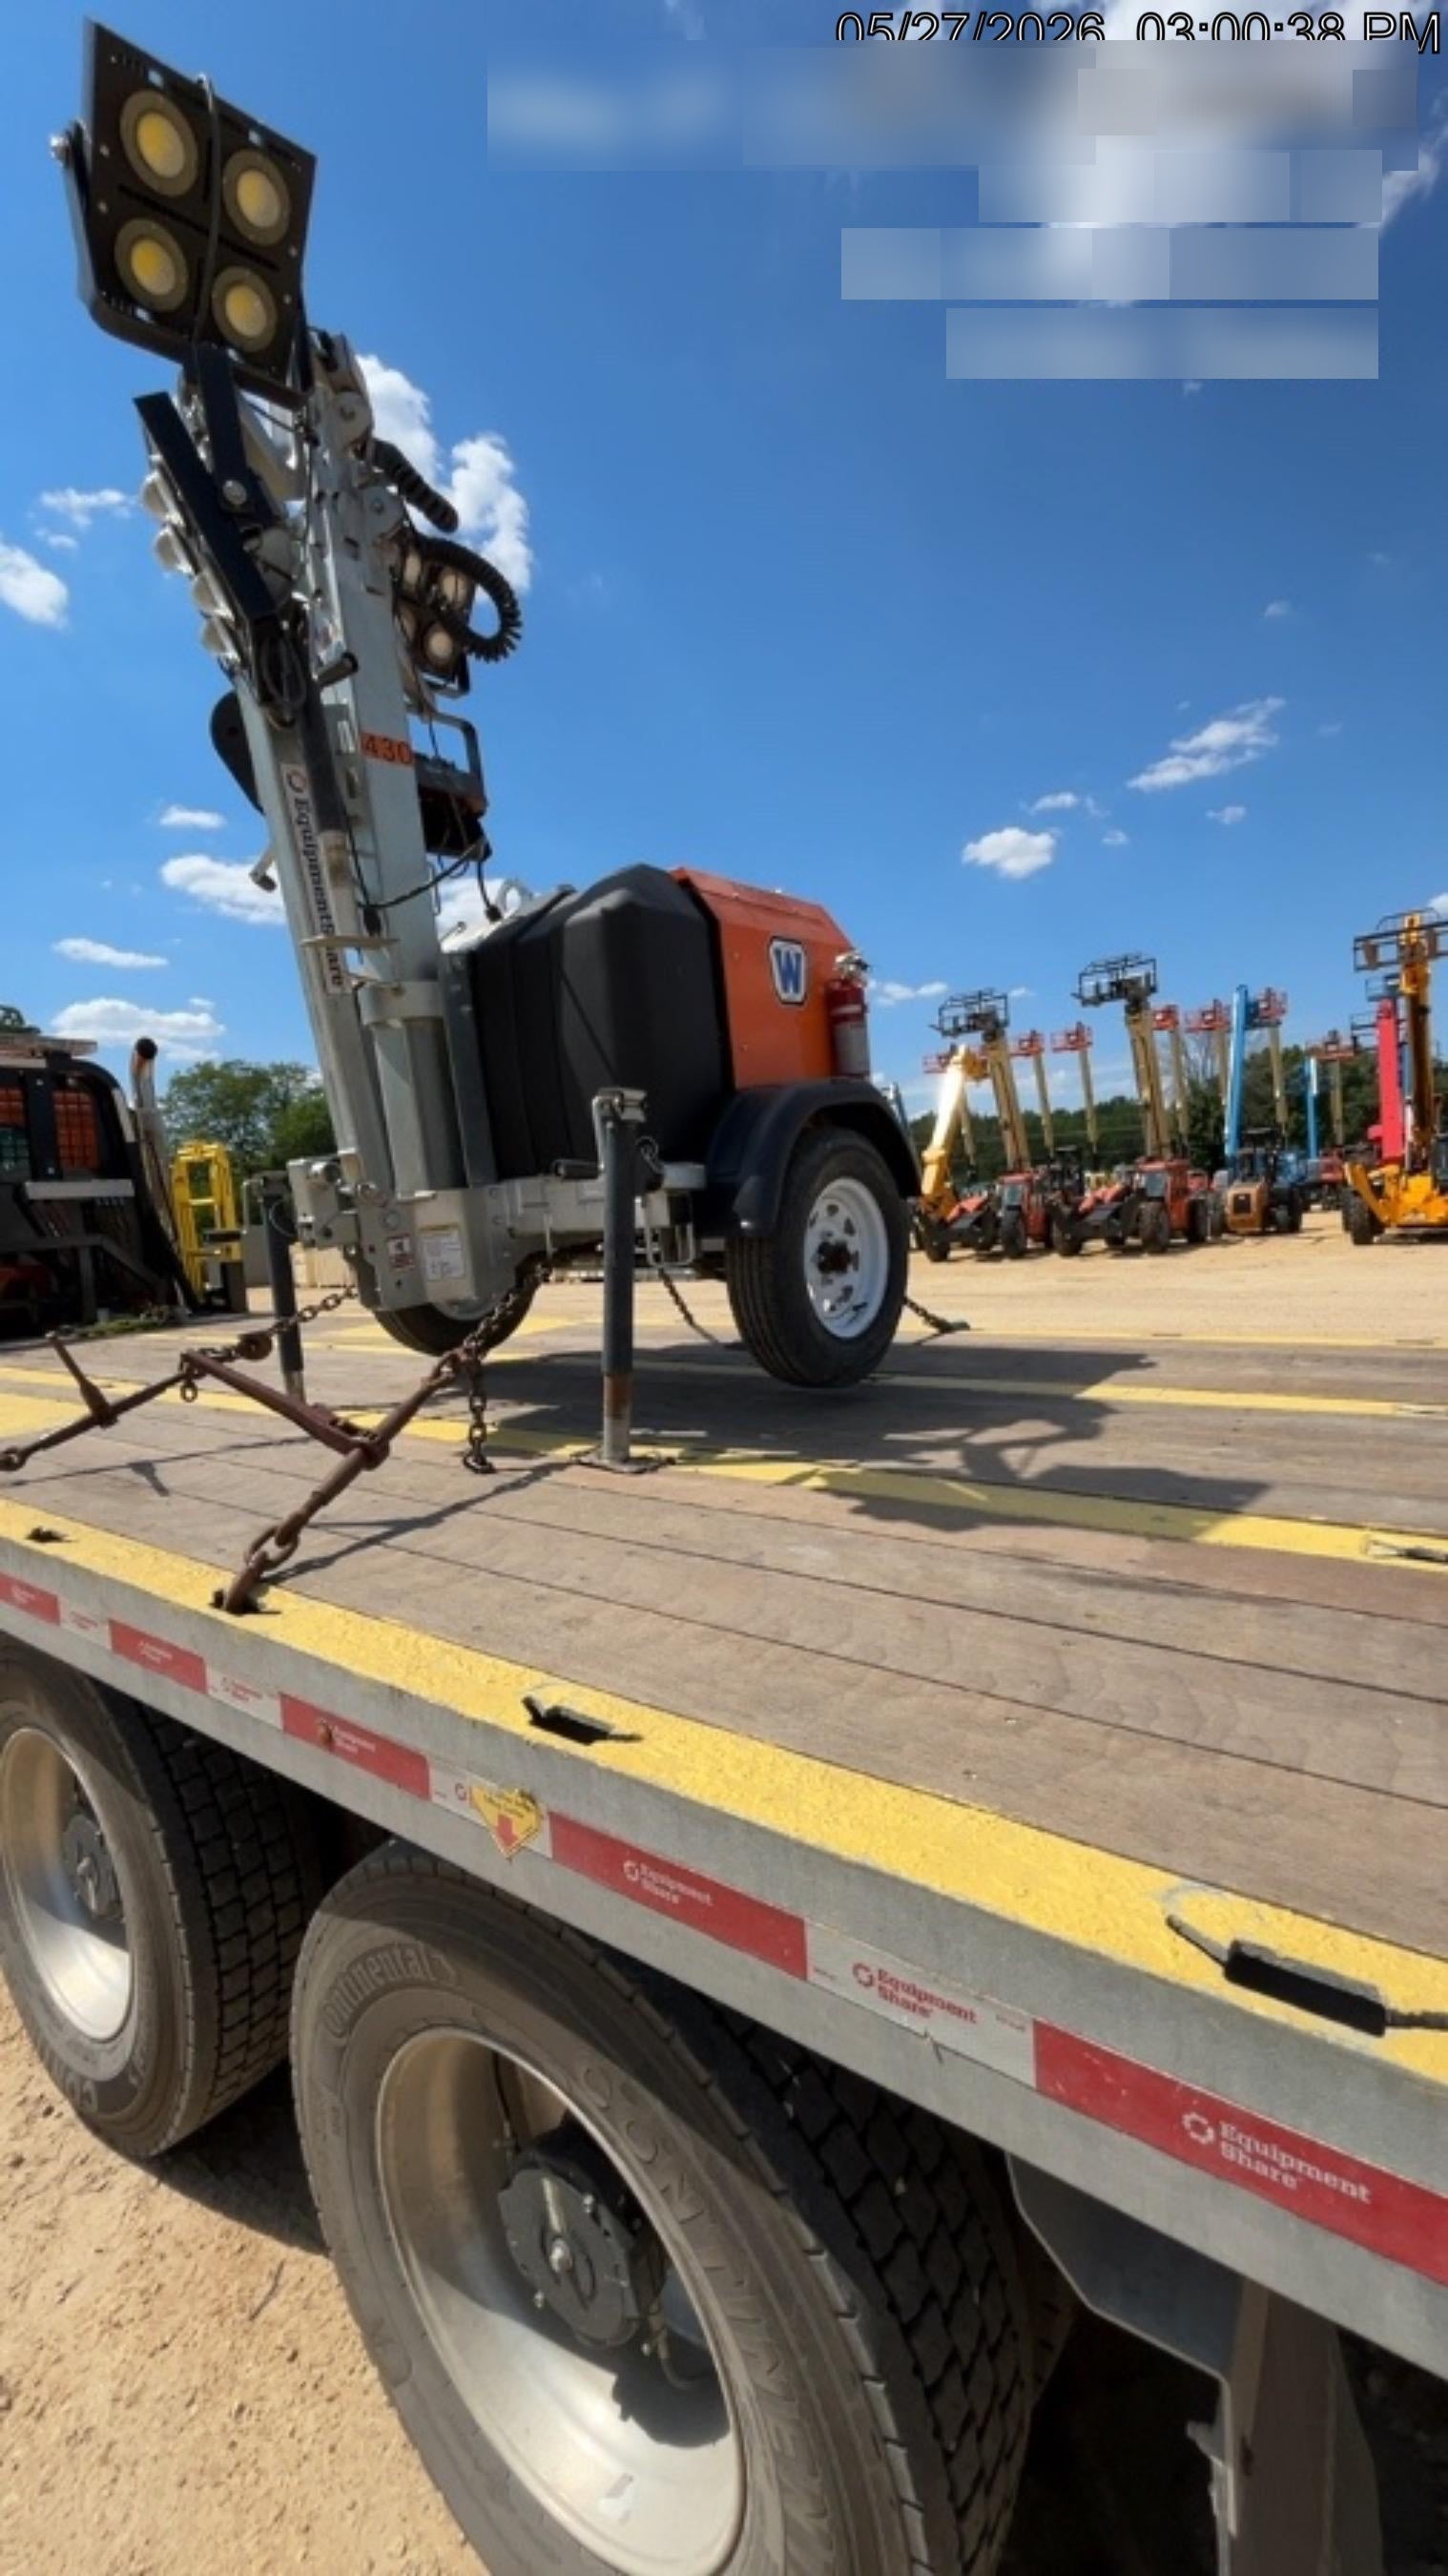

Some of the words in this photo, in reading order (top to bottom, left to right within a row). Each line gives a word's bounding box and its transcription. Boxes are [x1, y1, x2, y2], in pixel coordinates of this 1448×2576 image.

[294, 797, 344, 987] EquipmentSare
[774, 946, 802, 995] W
[877, 1968, 978, 2024] Equipment
[877, 1984, 931, 2019] Share
[1219, 2120, 1372, 2205] Equipment
[1220, 2140, 1298, 2191] Share
